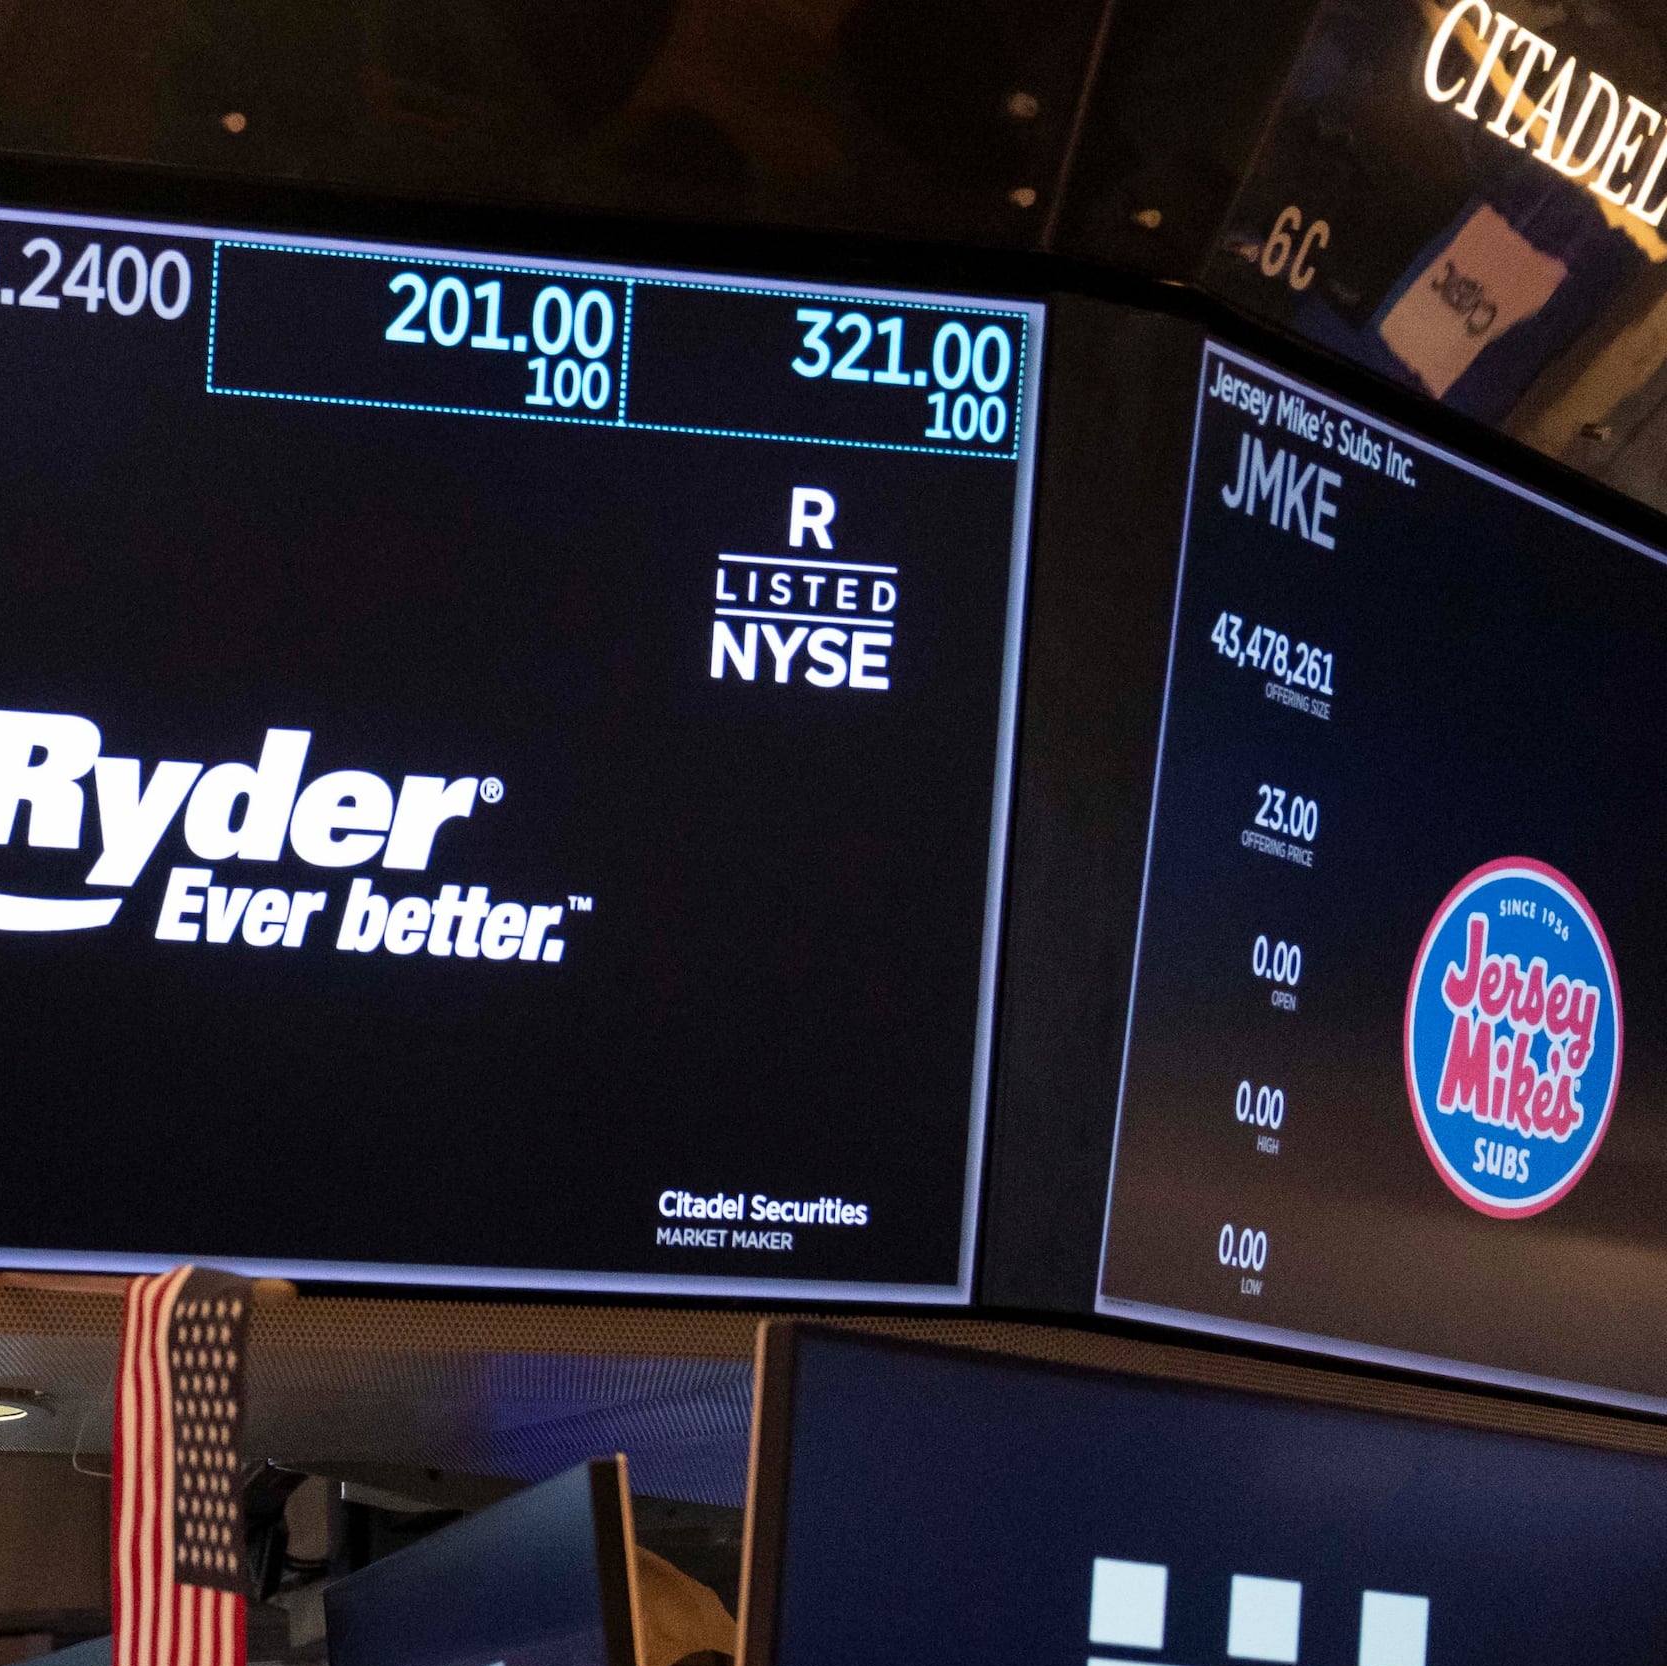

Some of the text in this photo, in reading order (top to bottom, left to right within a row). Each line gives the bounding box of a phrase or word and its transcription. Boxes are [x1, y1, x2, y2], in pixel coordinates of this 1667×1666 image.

[1261, 206, 1329, 290] 6C
[385, 272, 614, 359] 201.00
[792, 308, 1011, 391] 321.00
[526, 357, 611, 409] 100
[925, 392, 1007, 443] 100
[1209, 360, 1416, 488] Jersey Mike's Subs Inc.
[1222, 432, 1342, 549] JMKE
[789, 487, 836, 549] R
[716, 569, 897, 612] LISTED
[711, 620, 893, 690] NYSE
[1211, 612, 1334, 696] 43,478,261
[1254, 784, 1318, 842] 23.00
[155, 867, 328, 948] Ever
[1500, 899, 1568, 941] SINCE 1956
[1253, 935, 1301, 985] 0.00
[1272, 991, 1296, 1010] OPEN
[1443, 914, 1600, 1070] Jersey
[1437, 1014, 1585, 1143] Mike's
[1236, 1081, 1284, 1129] 0.00
[1257, 1136, 1279, 1154] HIGH
[1473, 1138, 1530, 1183] SUBS
[659, 1190, 868, 1225] Citadel Securities
[657, 1228, 793, 1249] MARKET MAKER
[1219, 1224, 1267, 1271] 0.00
[1241, 1278, 1262, 1295] LOW
